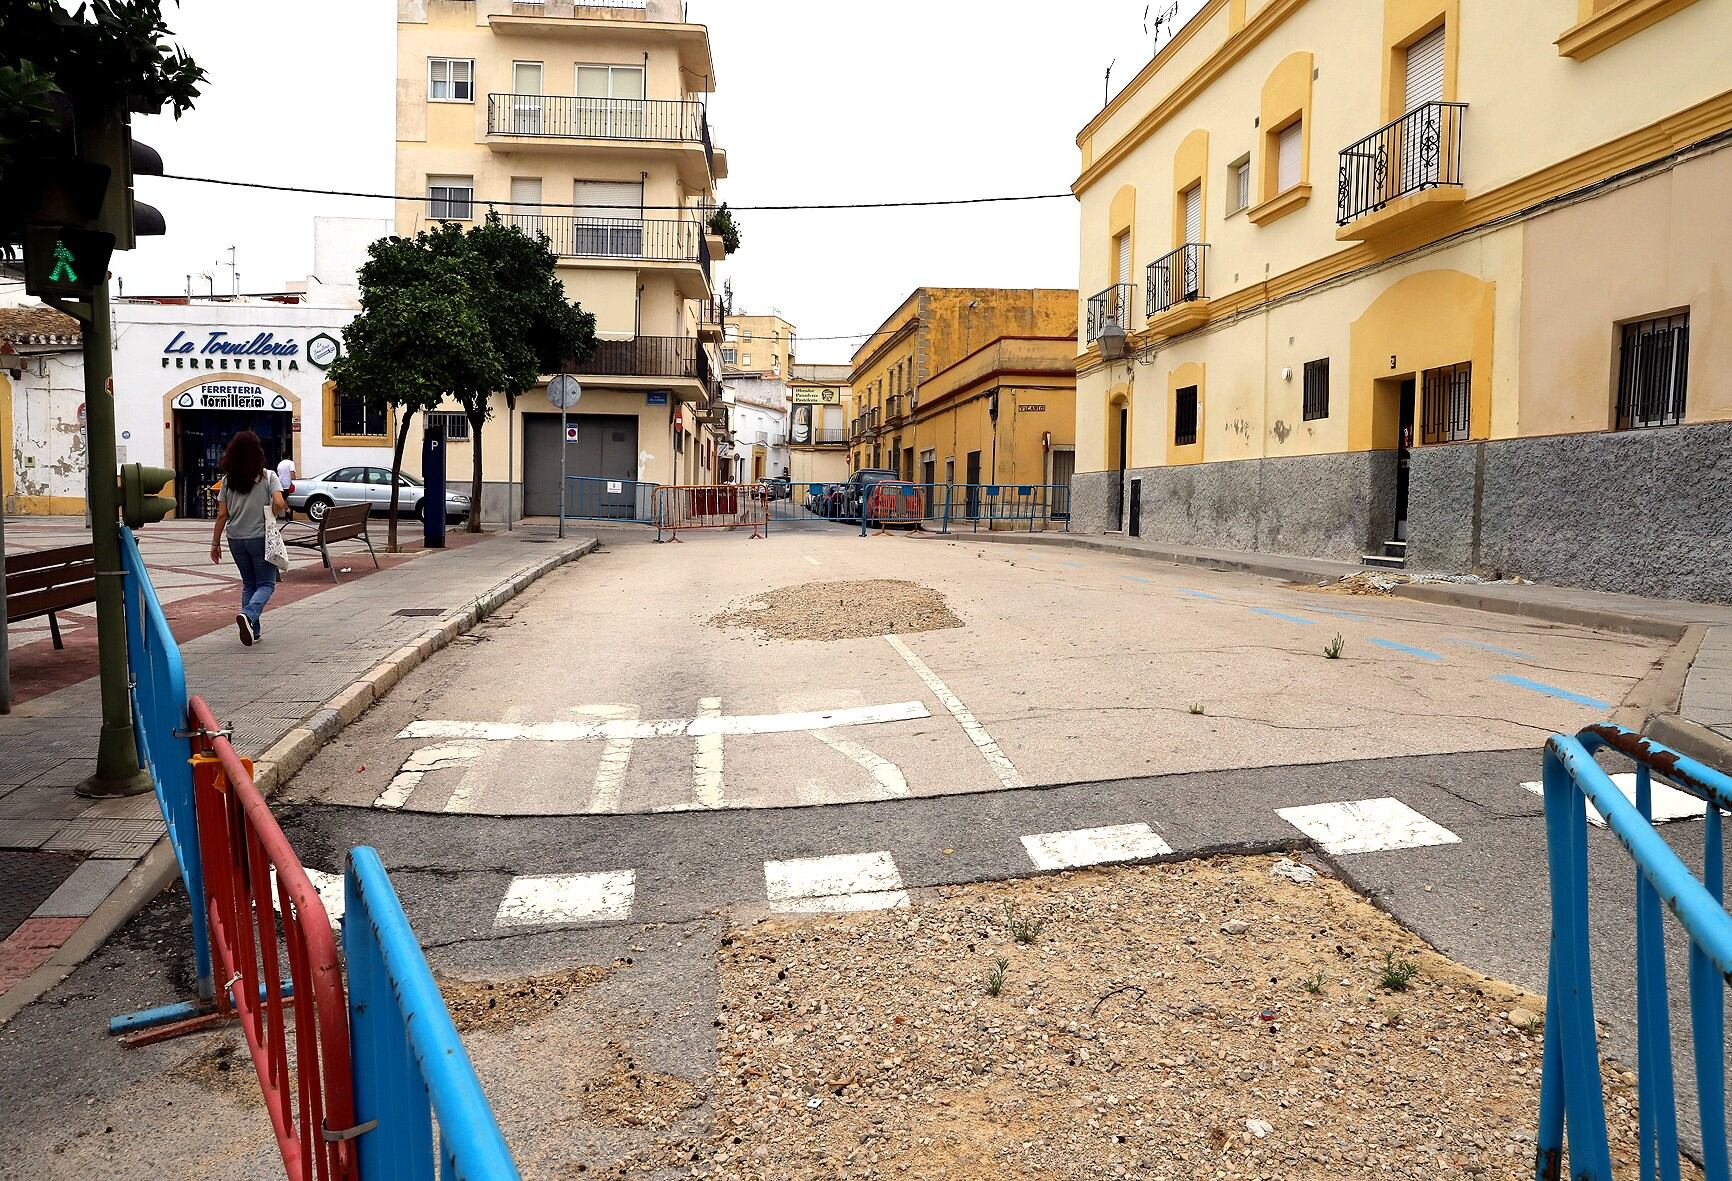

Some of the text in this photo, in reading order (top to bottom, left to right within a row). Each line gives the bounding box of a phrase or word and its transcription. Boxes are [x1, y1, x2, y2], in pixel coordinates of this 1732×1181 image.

[164, 331, 195, 354] La
[200, 331, 299, 356] Tornillería
[162, 358, 299, 371] FERRETERIA
[201, 385, 262, 395] FERRETERIA
[431, 440, 439, 451] P
